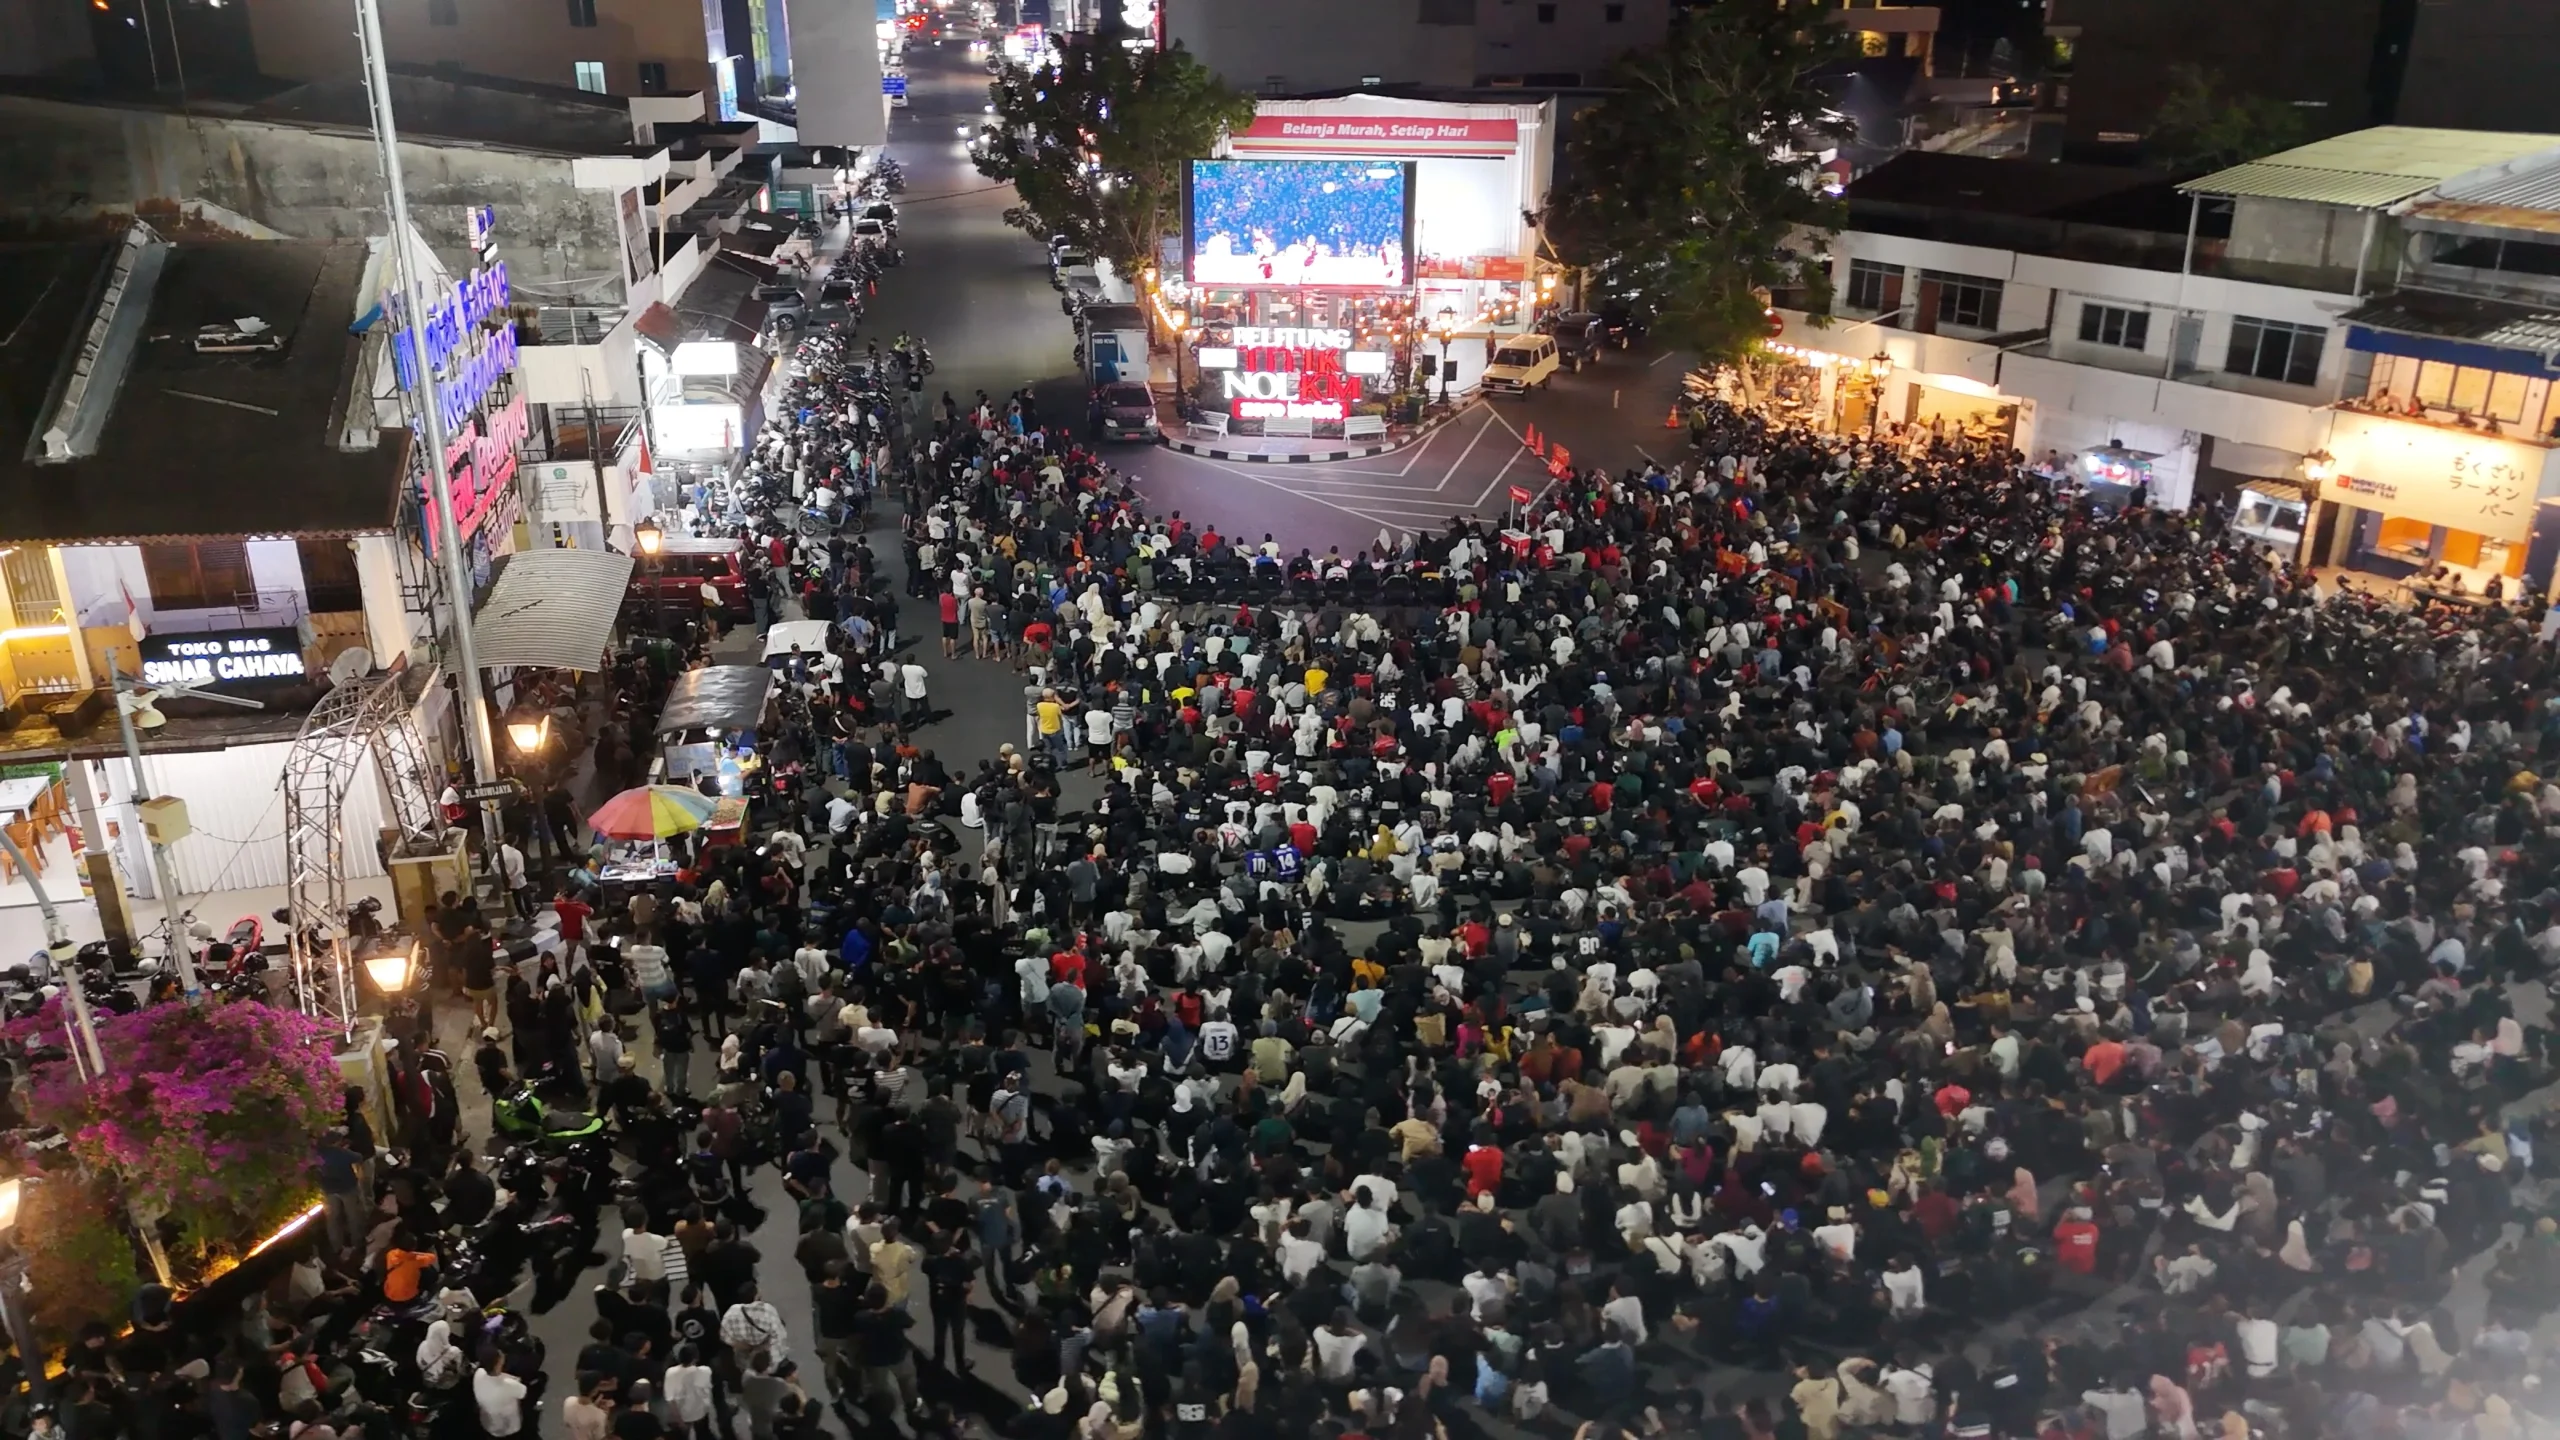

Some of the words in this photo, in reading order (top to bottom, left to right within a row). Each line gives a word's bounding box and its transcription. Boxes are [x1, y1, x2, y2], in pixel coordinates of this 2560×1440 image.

[1282, 122, 1335, 138] Belanja
[1337, 123, 1386, 138] Murah,
[1389, 124, 1435, 139] Setiap
[1437, 125, 1469, 137] Hari
[1233, 327, 1351, 350] BELITUNG
[1223, 371, 1300, 400] NOL
[1299, 374, 1362, 402] KM
[2449, 474, 2521, 501] ラーメン
[167, 641, 223, 656] TOKO
[228, 638, 271, 653] MAS
[143, 658, 213, 684] SINAR
[217, 653, 305, 680] CAHAYA
[1252, 857, 1266, 873] 10
[1278, 853, 1296, 871] 14
[1212, 1036, 1229, 1051] 13
